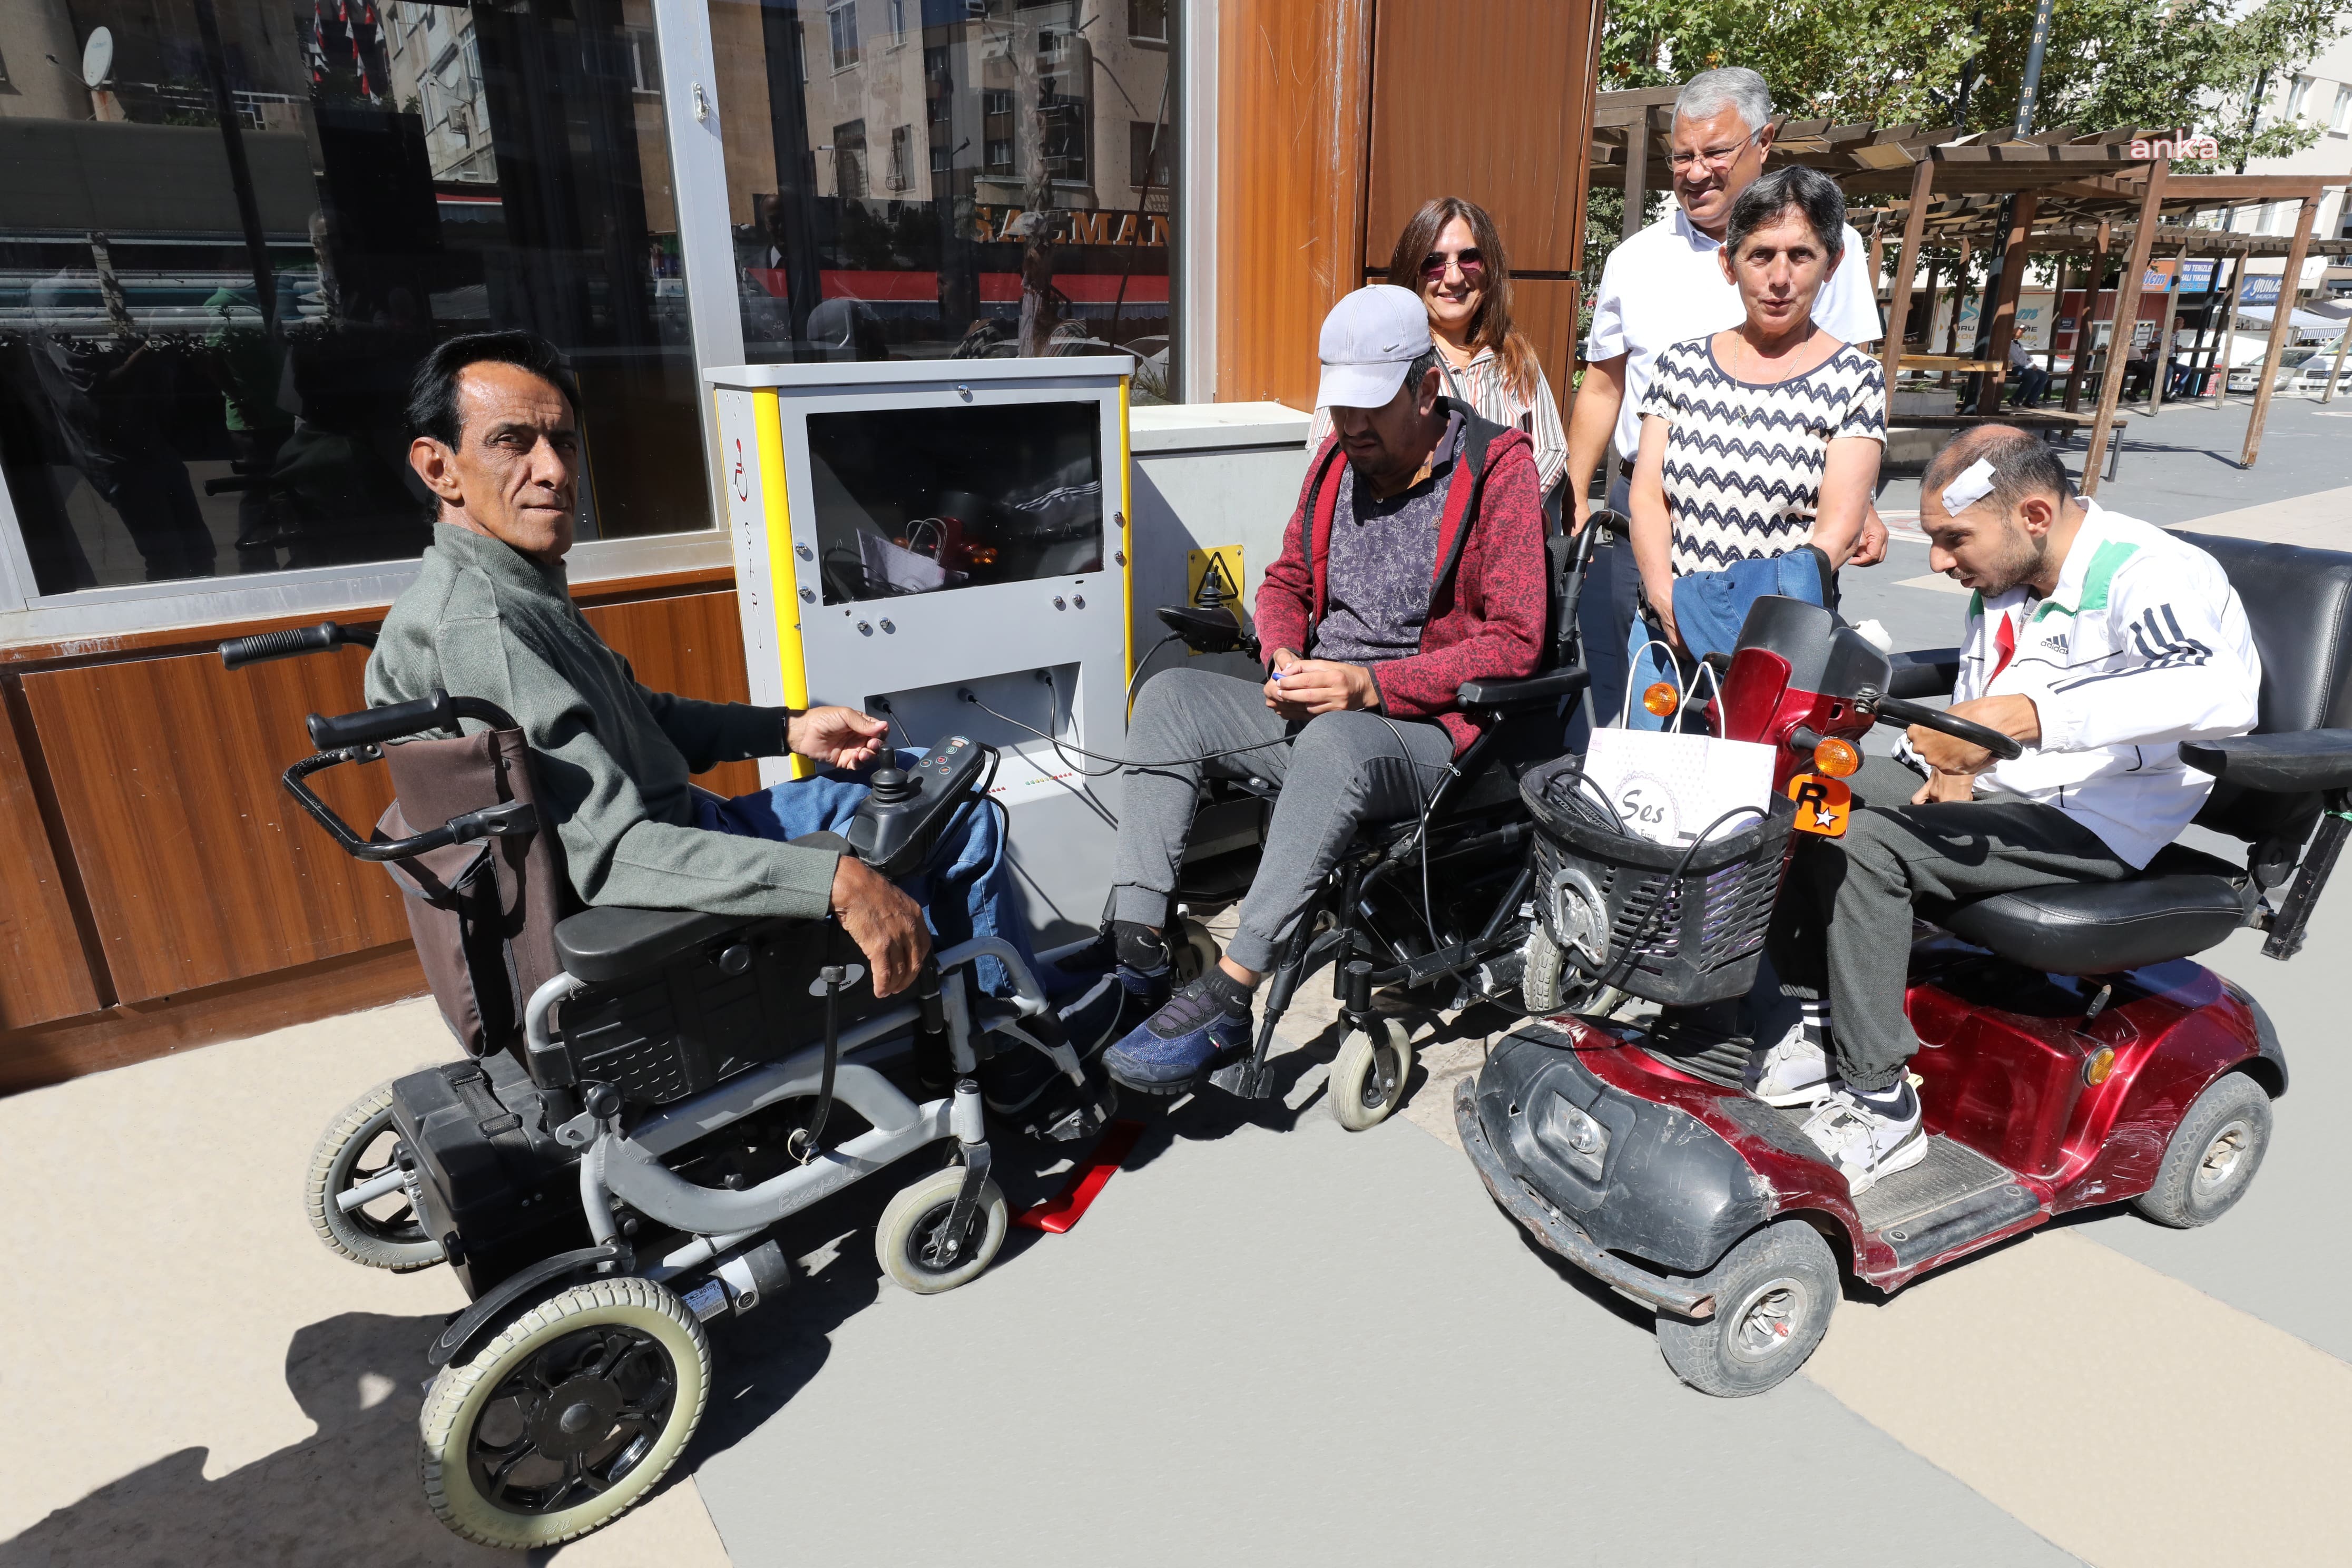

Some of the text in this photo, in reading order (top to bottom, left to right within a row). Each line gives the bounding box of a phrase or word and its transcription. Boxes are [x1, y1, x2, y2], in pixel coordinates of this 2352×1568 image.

[743, 522, 763, 650] ŞARJ
[2040, 641, 2069, 654] adidas
[1619, 789, 1665, 824] Ses
[1795, 781, 1828, 818] R
[778, 1175, 838, 1212] Escape
[699, 1283, 717, 1296] MOTOR
